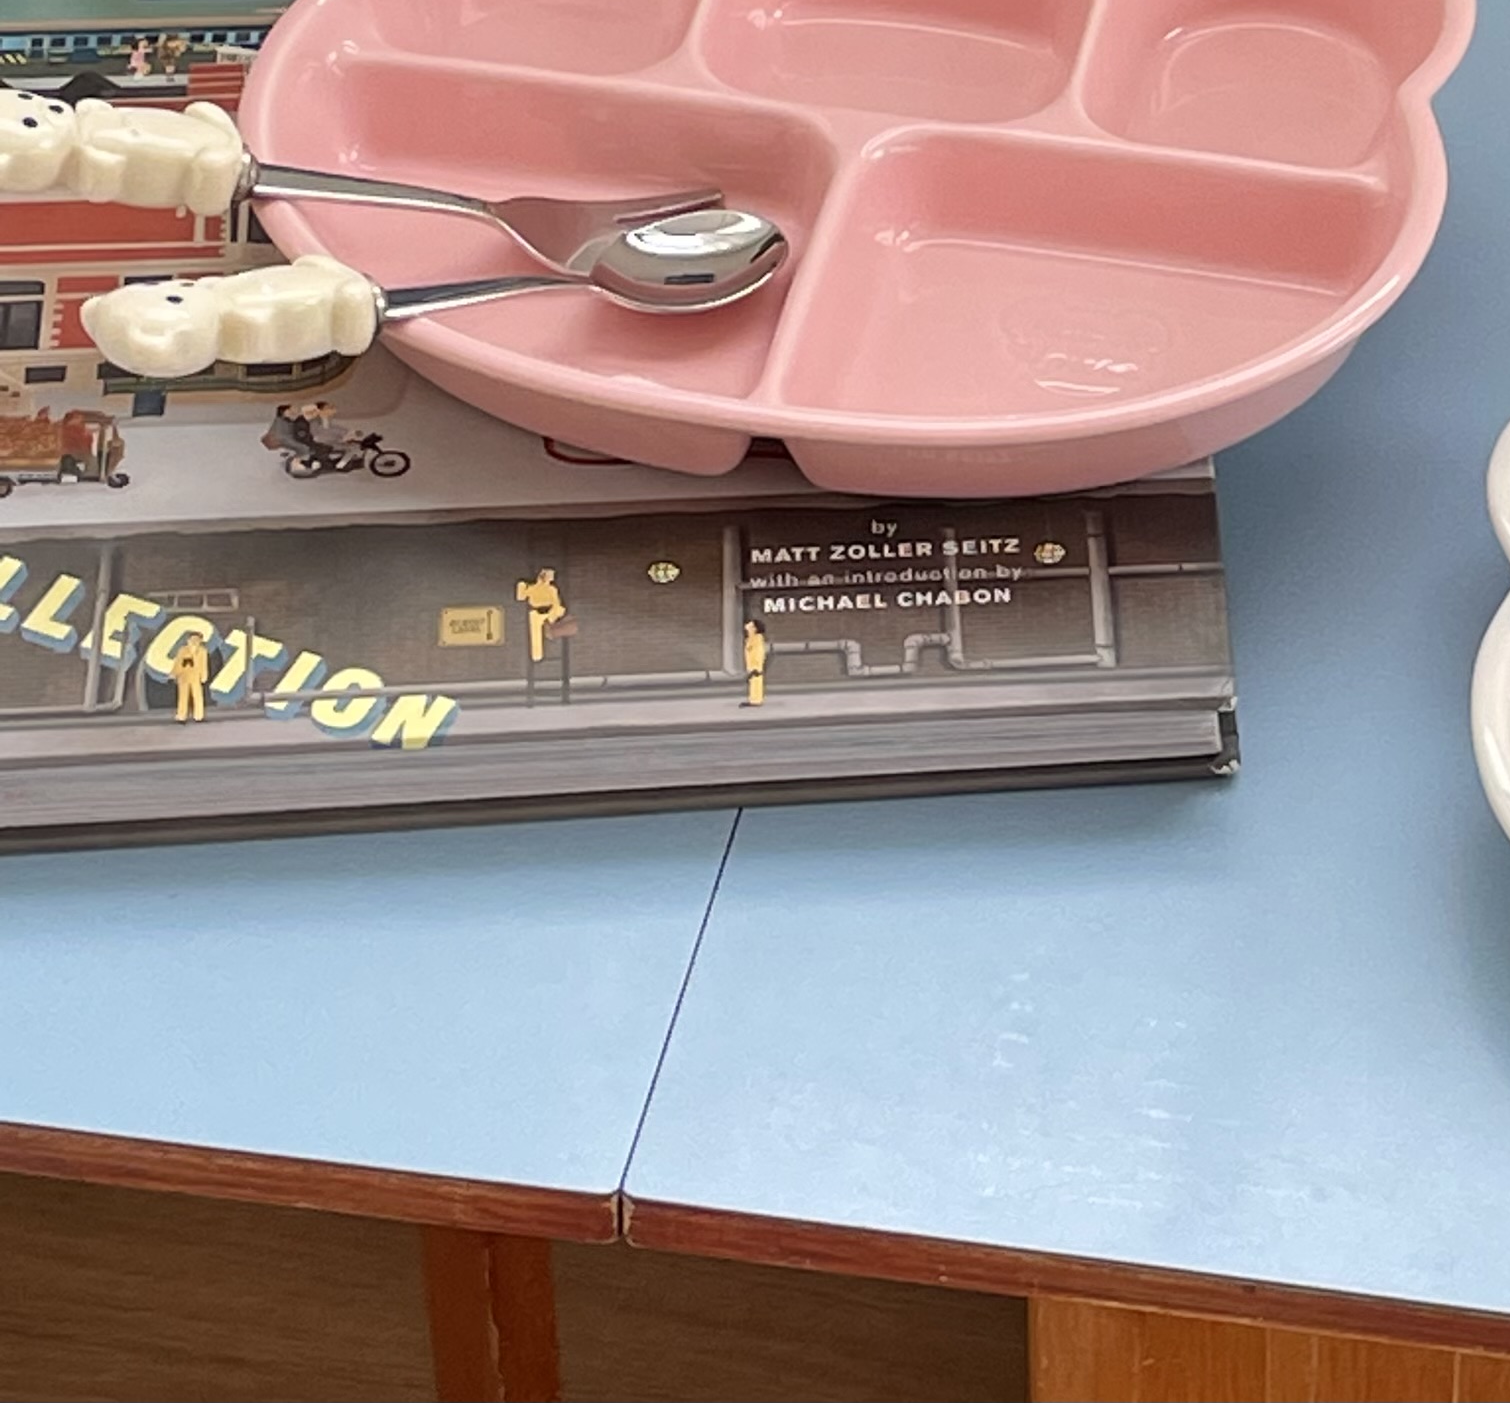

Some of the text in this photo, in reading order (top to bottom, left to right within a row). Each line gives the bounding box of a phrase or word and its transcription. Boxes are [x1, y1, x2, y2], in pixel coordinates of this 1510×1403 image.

[871, 518, 898, 538] by
[751, 537, 1021, 564] MATT ZOLLER SEITZ
[750, 571, 800, 590] with
[844, 565, 988, 584] introducton
[995, 563, 1023, 582] by
[763, 586, 1013, 614] MICHAEL CHABON
